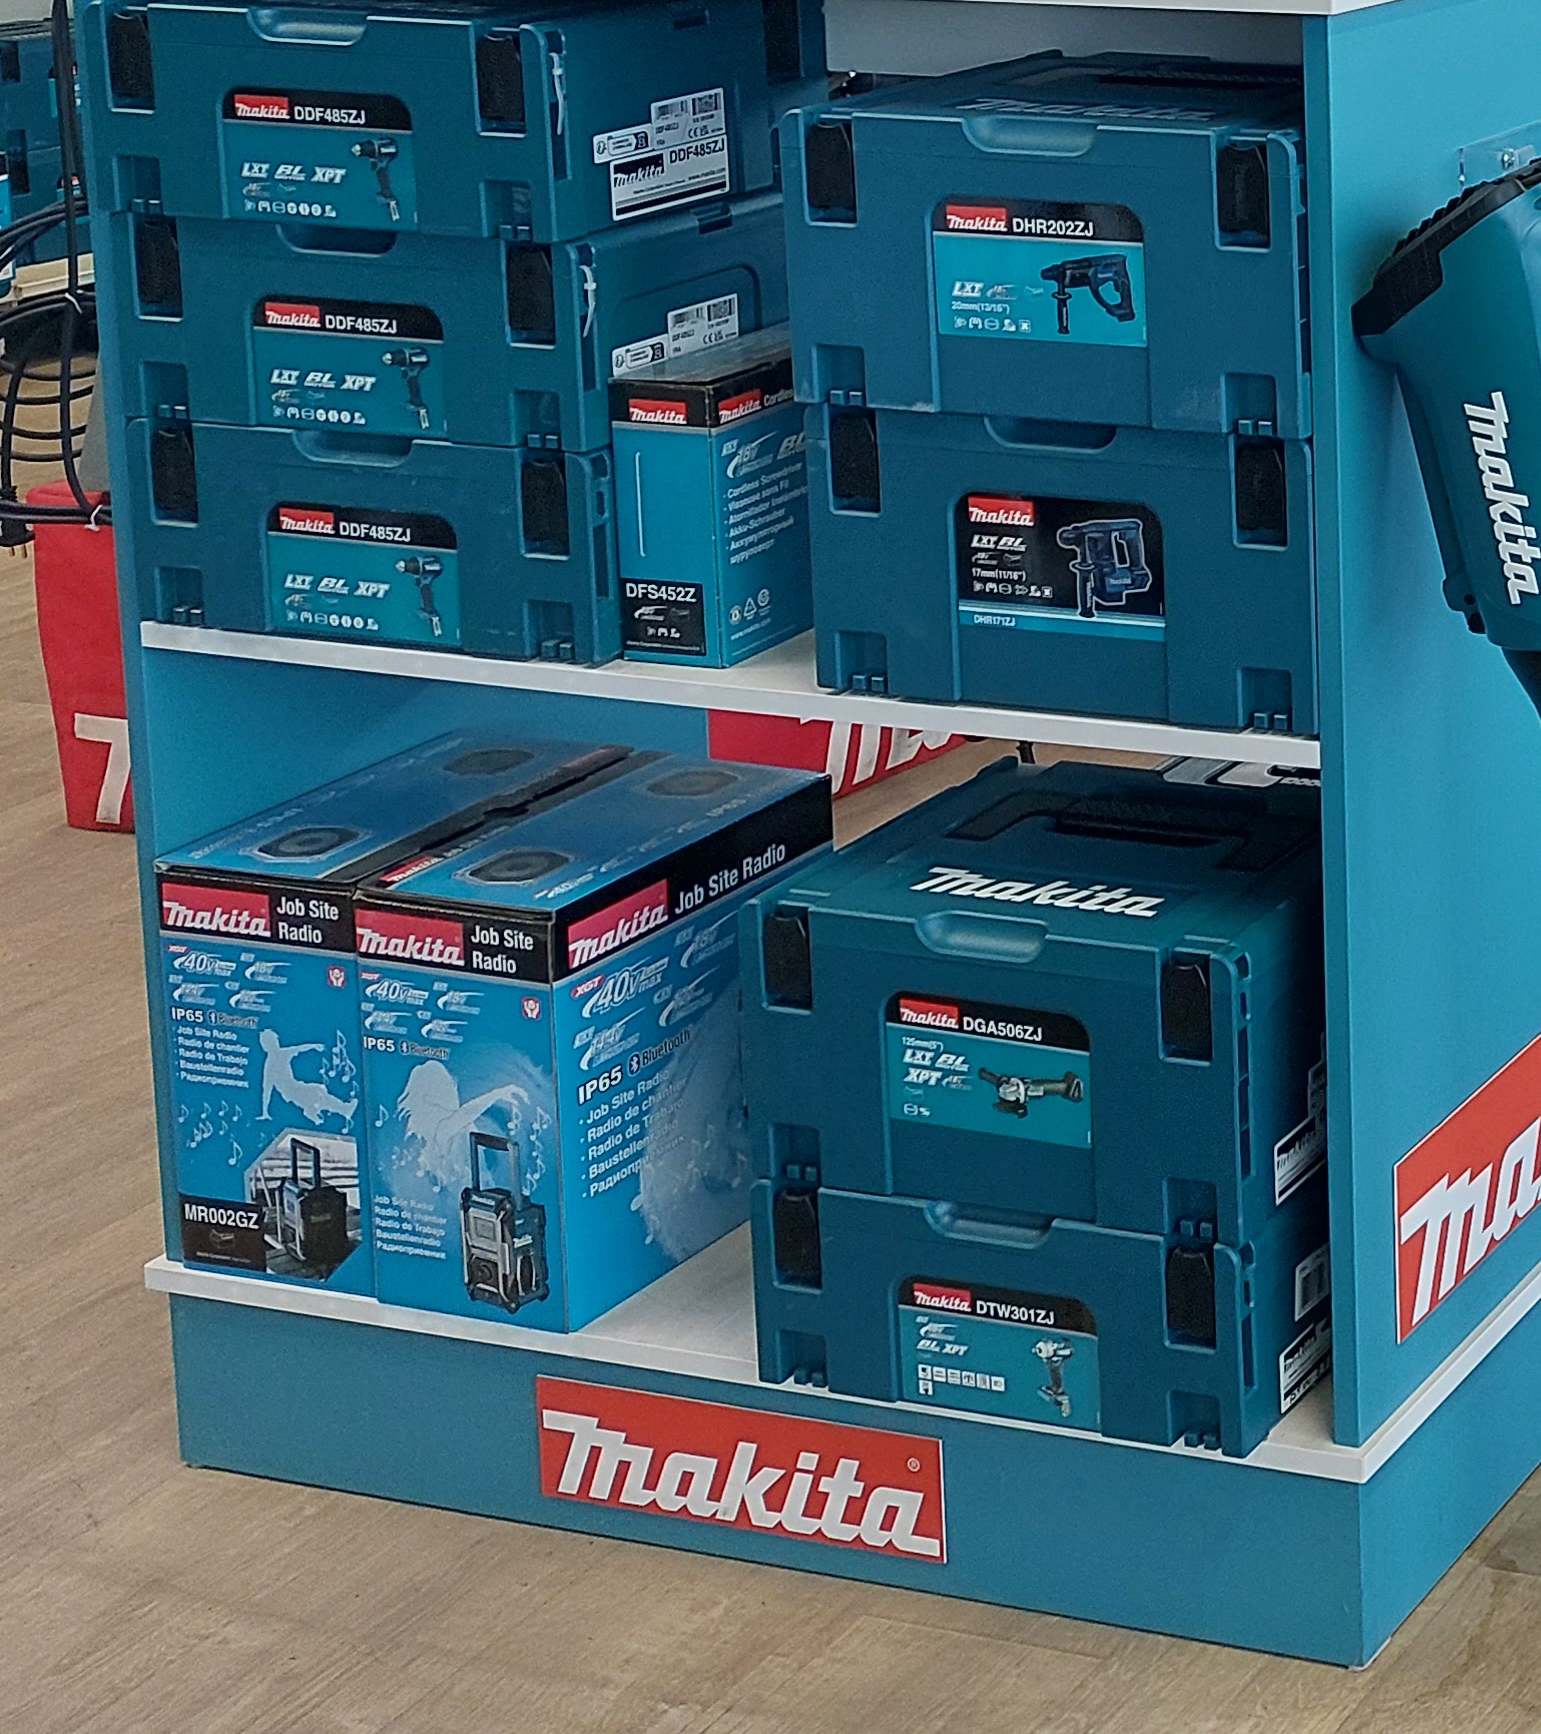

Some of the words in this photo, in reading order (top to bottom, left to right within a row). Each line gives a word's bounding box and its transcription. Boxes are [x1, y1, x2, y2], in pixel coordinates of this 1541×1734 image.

[235, 103, 291, 119] Makita
[294, 106, 366, 124] DDF485ZJ
[241, 162, 270, 178] LXT
[311, 167, 346, 184] XPT
[614, 165, 665, 188] Makita
[669, 138, 725, 163] DDF485ZJ
[947, 215, 1008, 232] Makita
[1012, 217, 1094, 237] DHR202ZJ
[952, 280, 984, 297] LXT
[265, 311, 321, 328] Makita
[325, 315, 397, 334] DDF485ZJ
[270, 369, 300, 385] LXT
[340, 374, 376, 391] XPT
[629, 407, 687, 424] Makita
[719, 399, 762, 424] Makita
[1463, 391, 1541, 605] Makita
[969, 507, 1034, 526] Makita
[280, 517, 336, 535] Makita
[339, 522, 411, 542] DDF485ZJ
[971, 535, 999, 549] LXT
[284, 573, 314, 591] LXT
[354, 580, 391, 599] XPT
[626, 582, 697, 603] DFS452Z
[909, 866, 1170, 919] Makita
[277, 896, 305, 917] Job
[309, 900, 339, 921] Site
[568, 903, 668, 969] Makita
[675, 883, 704, 915] Job
[709, 867, 738, 898] Site
[742, 844, 786, 880] Radio
[163, 901, 271, 938] Makita
[278, 922, 322, 944] Radio
[471, 925, 500, 945] Job
[503, 929, 534, 951] Site
[356, 927, 465, 966] Makita
[472, 951, 517, 974] Radio
[574, 976, 602, 997] XGT
[171, 1007, 203, 1023] IP65
[900, 1008, 959, 1029] Makita
[963, 1016, 1043, 1042] DGA506ZJ
[363, 1036, 395, 1052] IP65
[578, 1065, 622, 1105] IP65
[642, 1028, 691, 1066] Bluetooth
[903, 1067, 943, 1086] XPT
[586, 1104, 609, 1125] Job
[611, 1089, 635, 1109] Site
[637, 1069, 670, 1095] Radio
[587, 1116, 622, 1143] Radio
[624, 1105, 640, 1124] de
[588, 1134, 622, 1161] Radio
[625, 1123, 640, 1140] de
[184, 1203, 260, 1230] MR002GZ
[914, 1291, 972, 1312] Makita
[976, 1300, 1055, 1325] DTW301ZJ
[541, 1409, 941, 1557] Makita
